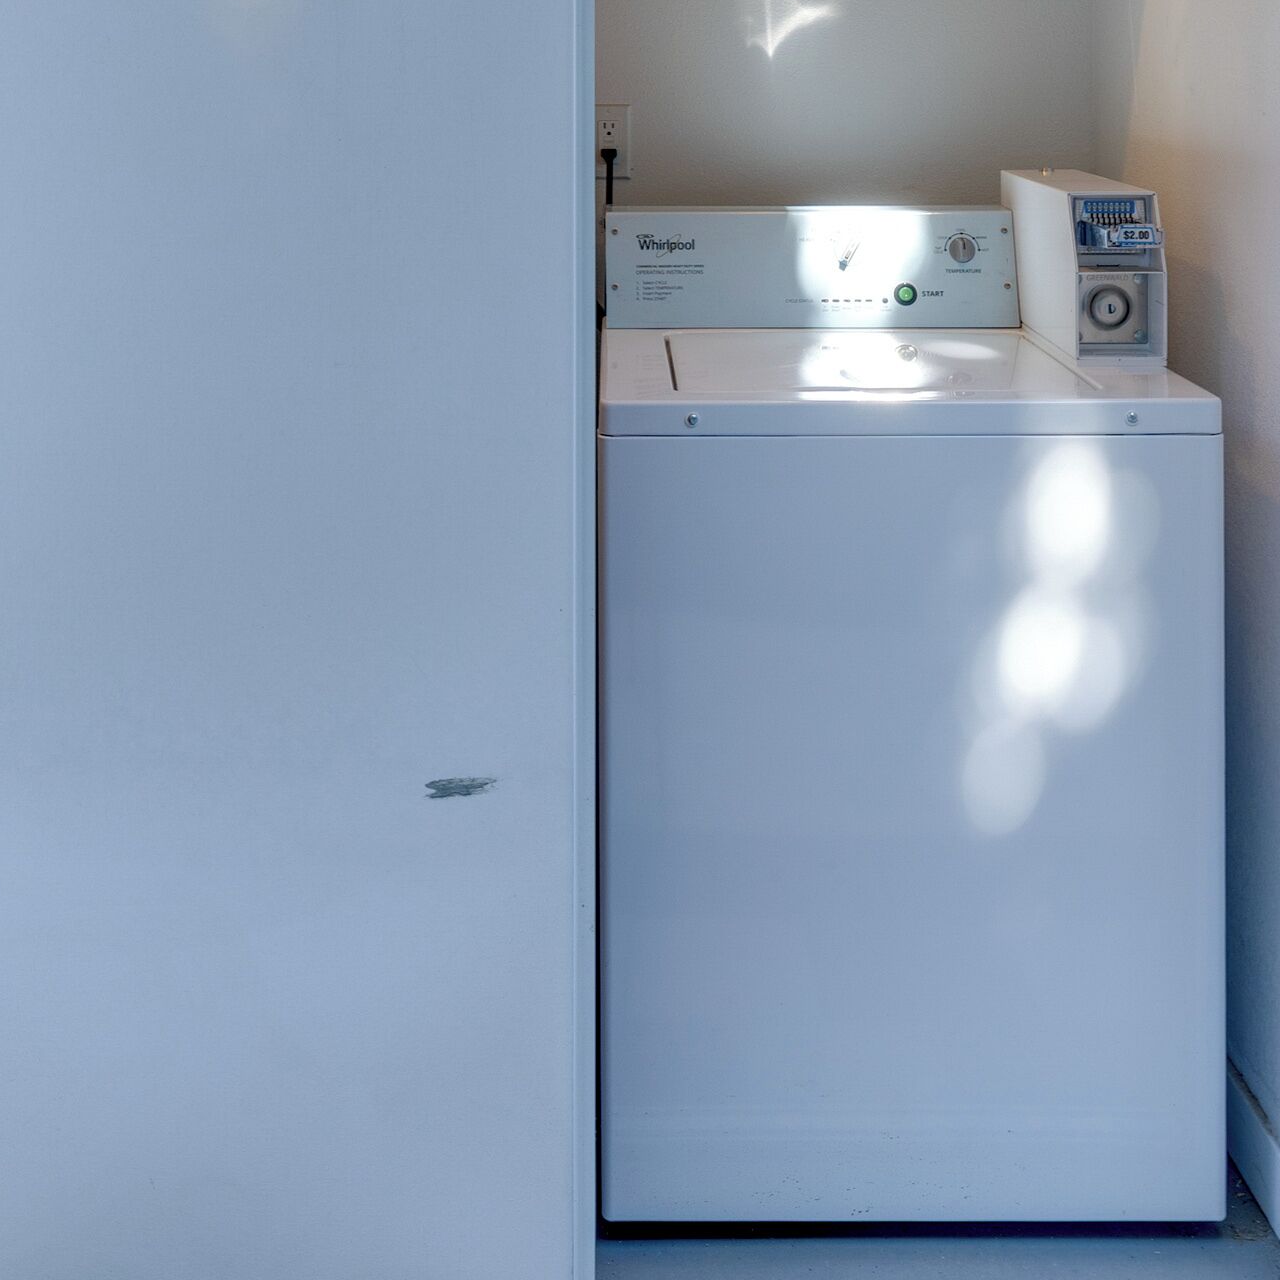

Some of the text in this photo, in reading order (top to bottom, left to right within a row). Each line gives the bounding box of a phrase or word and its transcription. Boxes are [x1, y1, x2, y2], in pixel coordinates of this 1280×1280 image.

[1123, 230, 1150, 240] $2.00
[637, 238, 695, 254] Whirlpool
[921, 290, 944, 298] START
